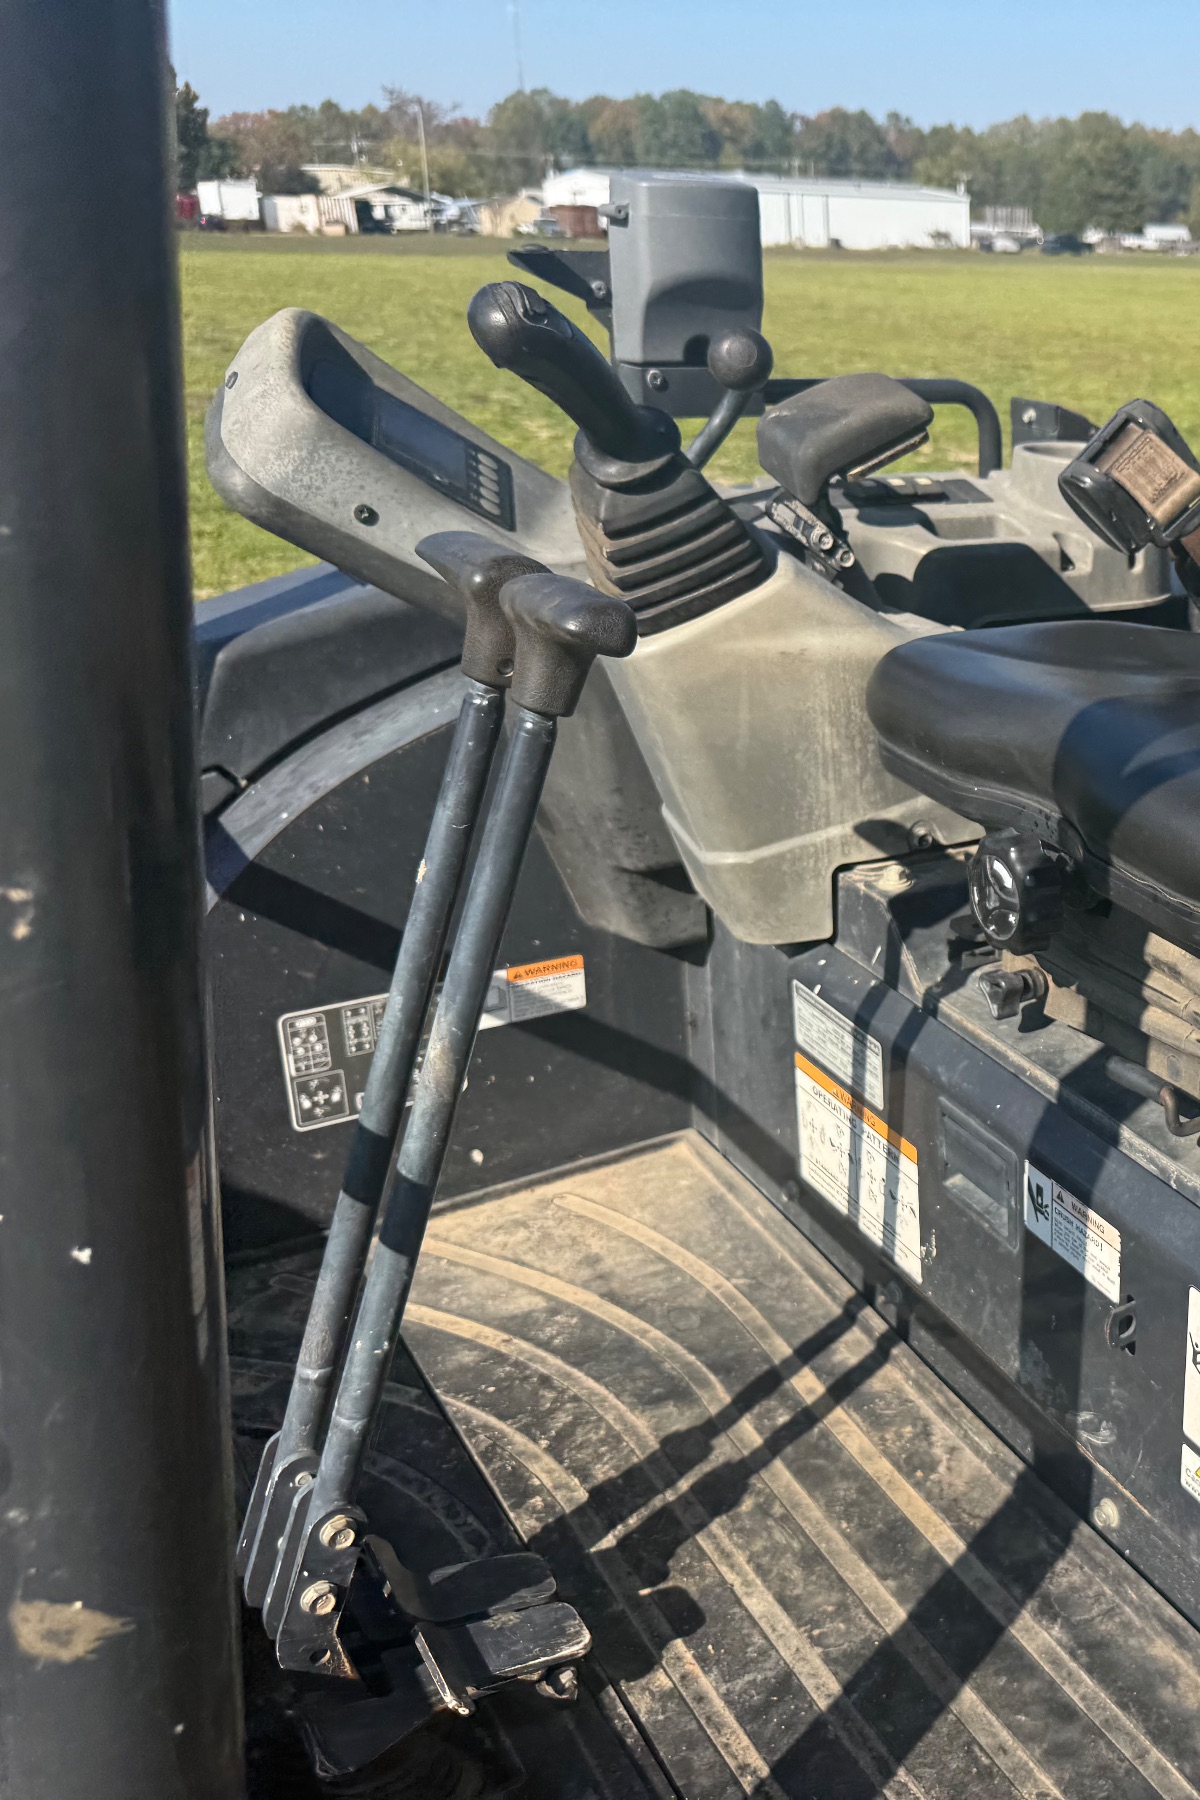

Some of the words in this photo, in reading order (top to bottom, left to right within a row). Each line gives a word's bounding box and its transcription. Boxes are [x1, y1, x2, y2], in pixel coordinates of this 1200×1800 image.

[524, 960, 578, 976] WARNING
[812, 1084, 856, 1129] OPERATING
[863, 1126, 899, 1164] PATTERN
[839, 1089, 875, 1128] WARNING
[1054, 1206, 1073, 1227] CRUSH
[1071, 1200, 1104, 1234] WARNING
